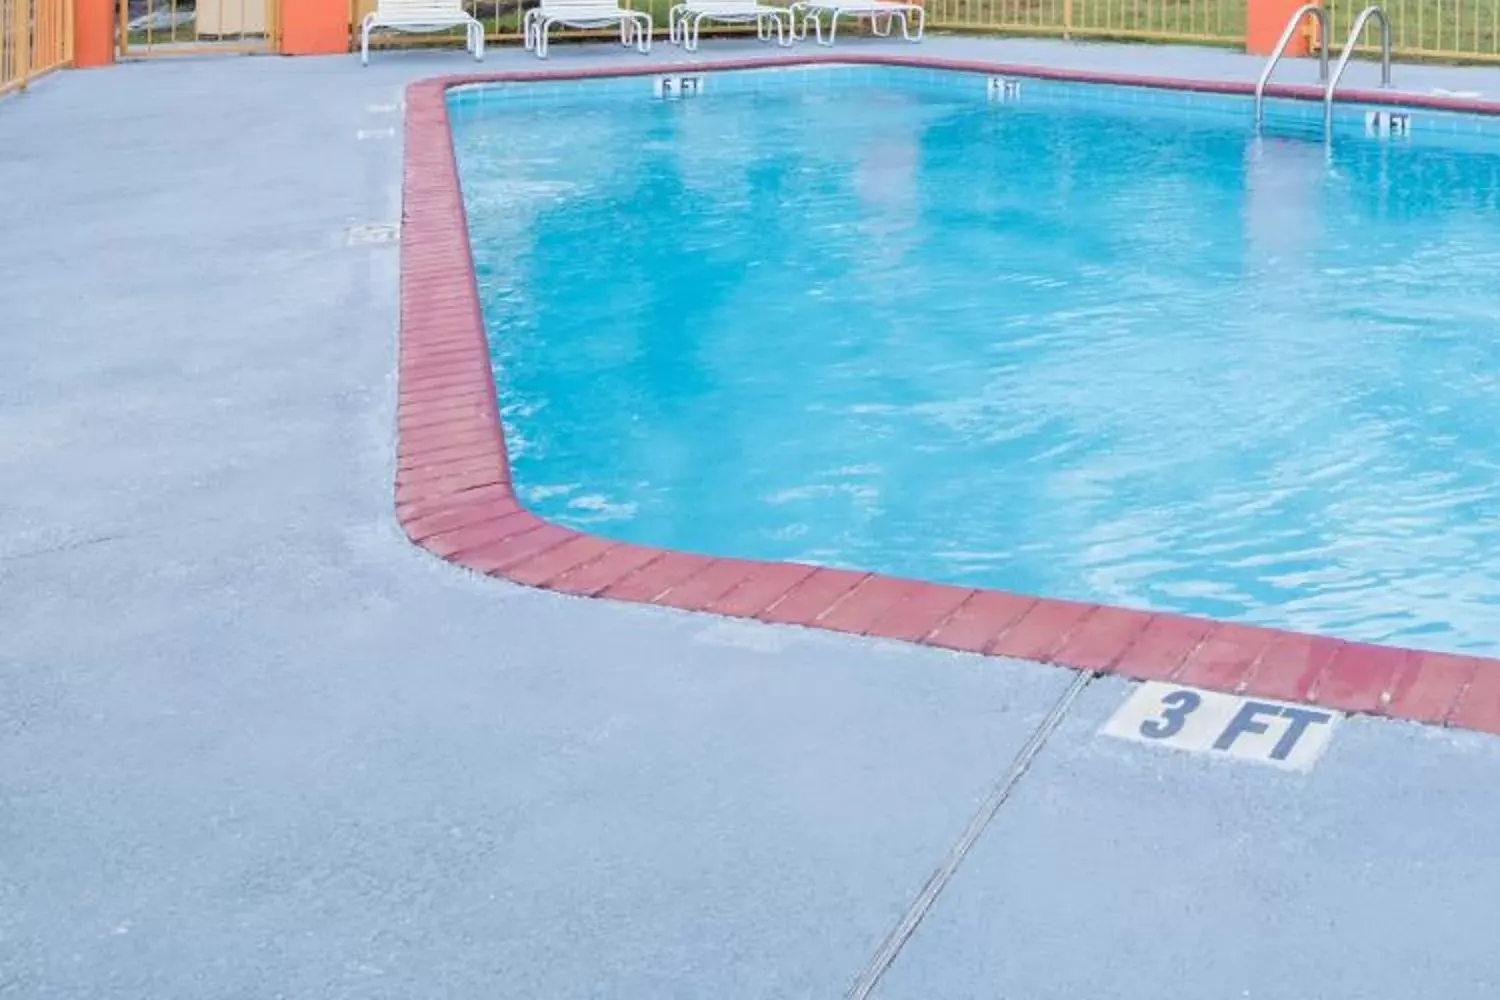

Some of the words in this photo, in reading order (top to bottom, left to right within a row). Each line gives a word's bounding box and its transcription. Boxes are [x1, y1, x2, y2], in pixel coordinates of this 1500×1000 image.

[680, 77, 701, 90] FT
[1389, 112, 1409, 129] FT
[1139, 689, 1201, 739] 3
[1212, 701, 1331, 760] FT
